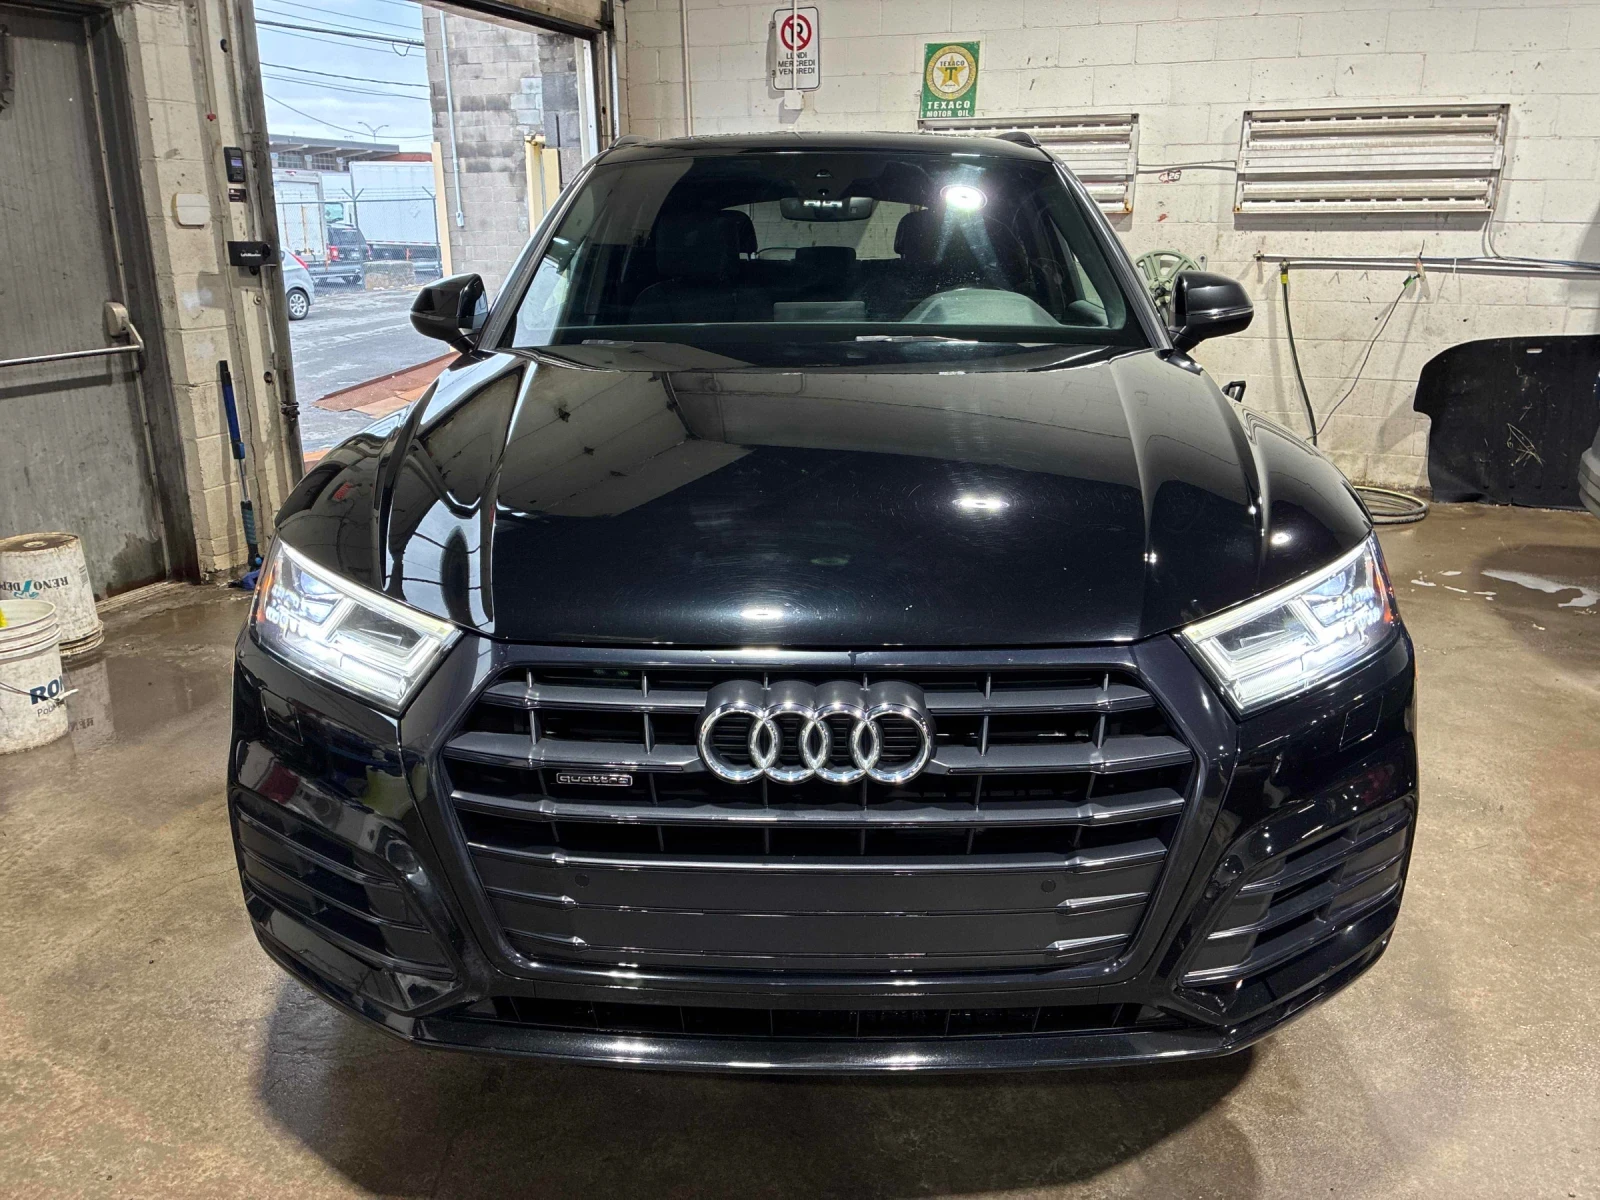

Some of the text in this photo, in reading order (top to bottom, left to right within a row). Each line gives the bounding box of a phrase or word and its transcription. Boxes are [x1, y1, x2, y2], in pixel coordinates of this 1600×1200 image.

[927, 100, 971, 109] TEXACO
[926, 109, 970, 118] MOTOR OIL
[559, 775, 629, 784] quattro
